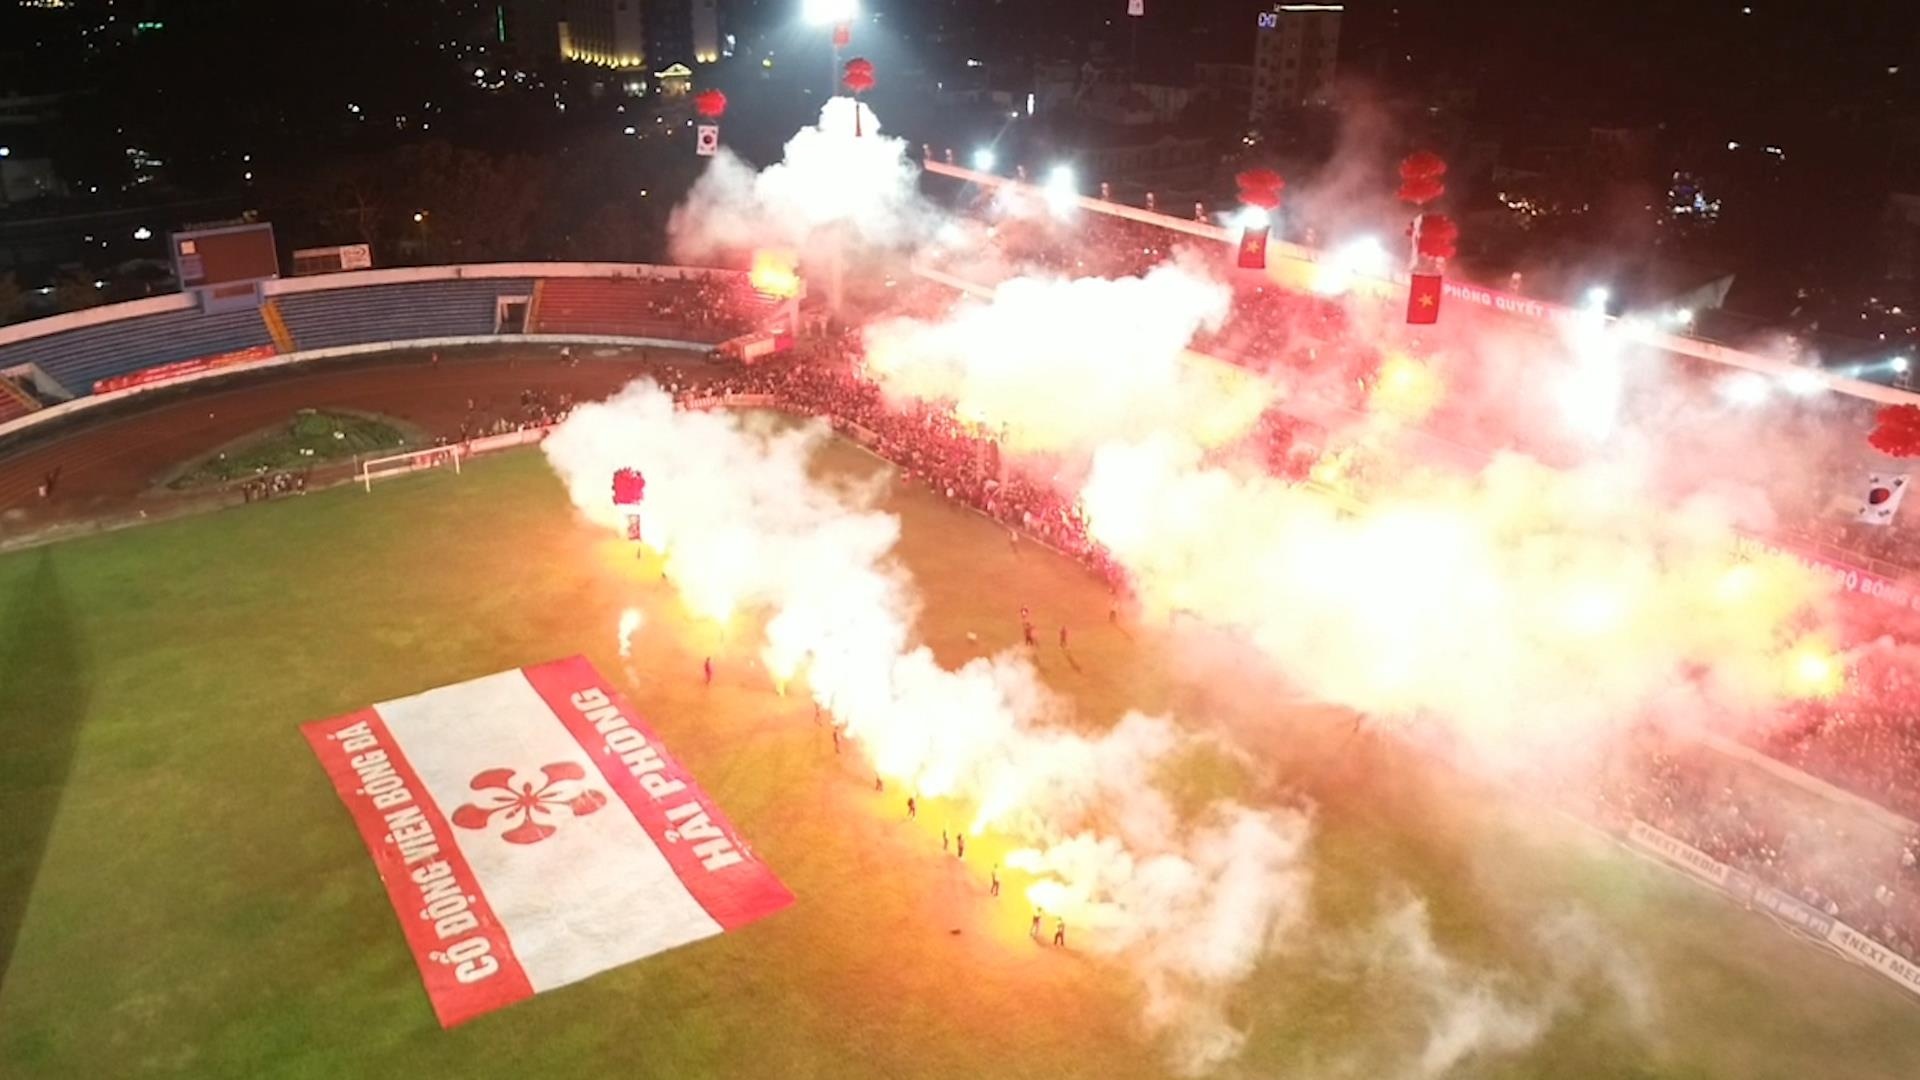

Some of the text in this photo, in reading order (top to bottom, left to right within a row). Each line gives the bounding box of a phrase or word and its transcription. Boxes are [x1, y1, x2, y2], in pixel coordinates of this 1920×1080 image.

[570, 686, 744, 872] HẢI PHÒNG
[326, 720, 499, 984] CỔ ĐỘNG VIÊN BÓNG ĐÁ
[1646, 830, 1723, 877] NEXT MEDIA
[1848, 936, 1886, 965] NEXT
